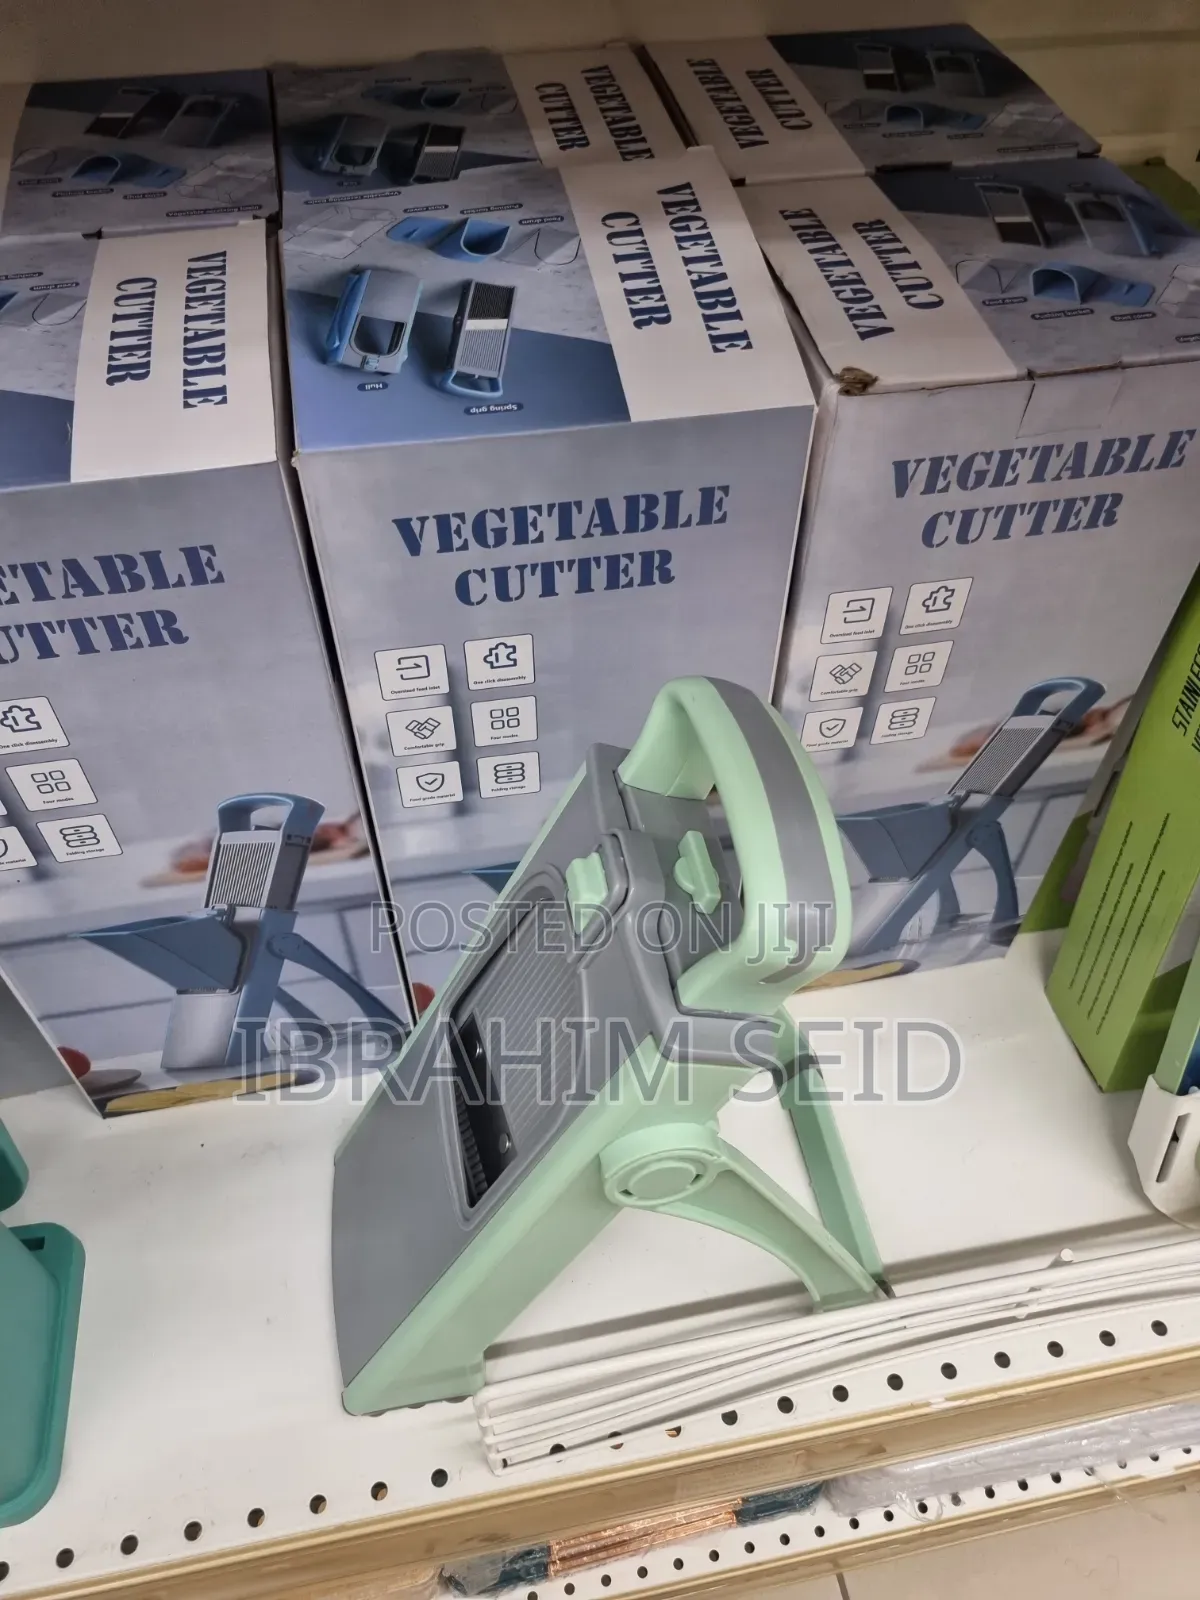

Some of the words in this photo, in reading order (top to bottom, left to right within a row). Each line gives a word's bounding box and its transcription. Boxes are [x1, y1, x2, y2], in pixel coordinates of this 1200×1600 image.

[535, 82, 590, 151] CUTTER
[581, 65, 655, 162] VEGETABLE
[686, 59, 769, 150] VEGETABLE
[745, 68, 813, 130] CUTTER
[601, 212, 672, 330] CUTTER
[657, 182, 753, 353] VEGETABLE
[778, 208, 895, 341] VEGETABLE
[852, 219, 945, 310] CUTTER
[106, 277, 157, 386] CUTTER
[183, 250, 228, 409] VEGETABLE
[470, 405, 488, 414] grip
[489, 404, 518, 412] Spring
[892, 429, 1197, 498] VEGETABLE
[391, 485, 730, 557] VEGETABLE
[921, 492, 1124, 548] CUTTER
[455, 549, 675, 606] CUTTER
